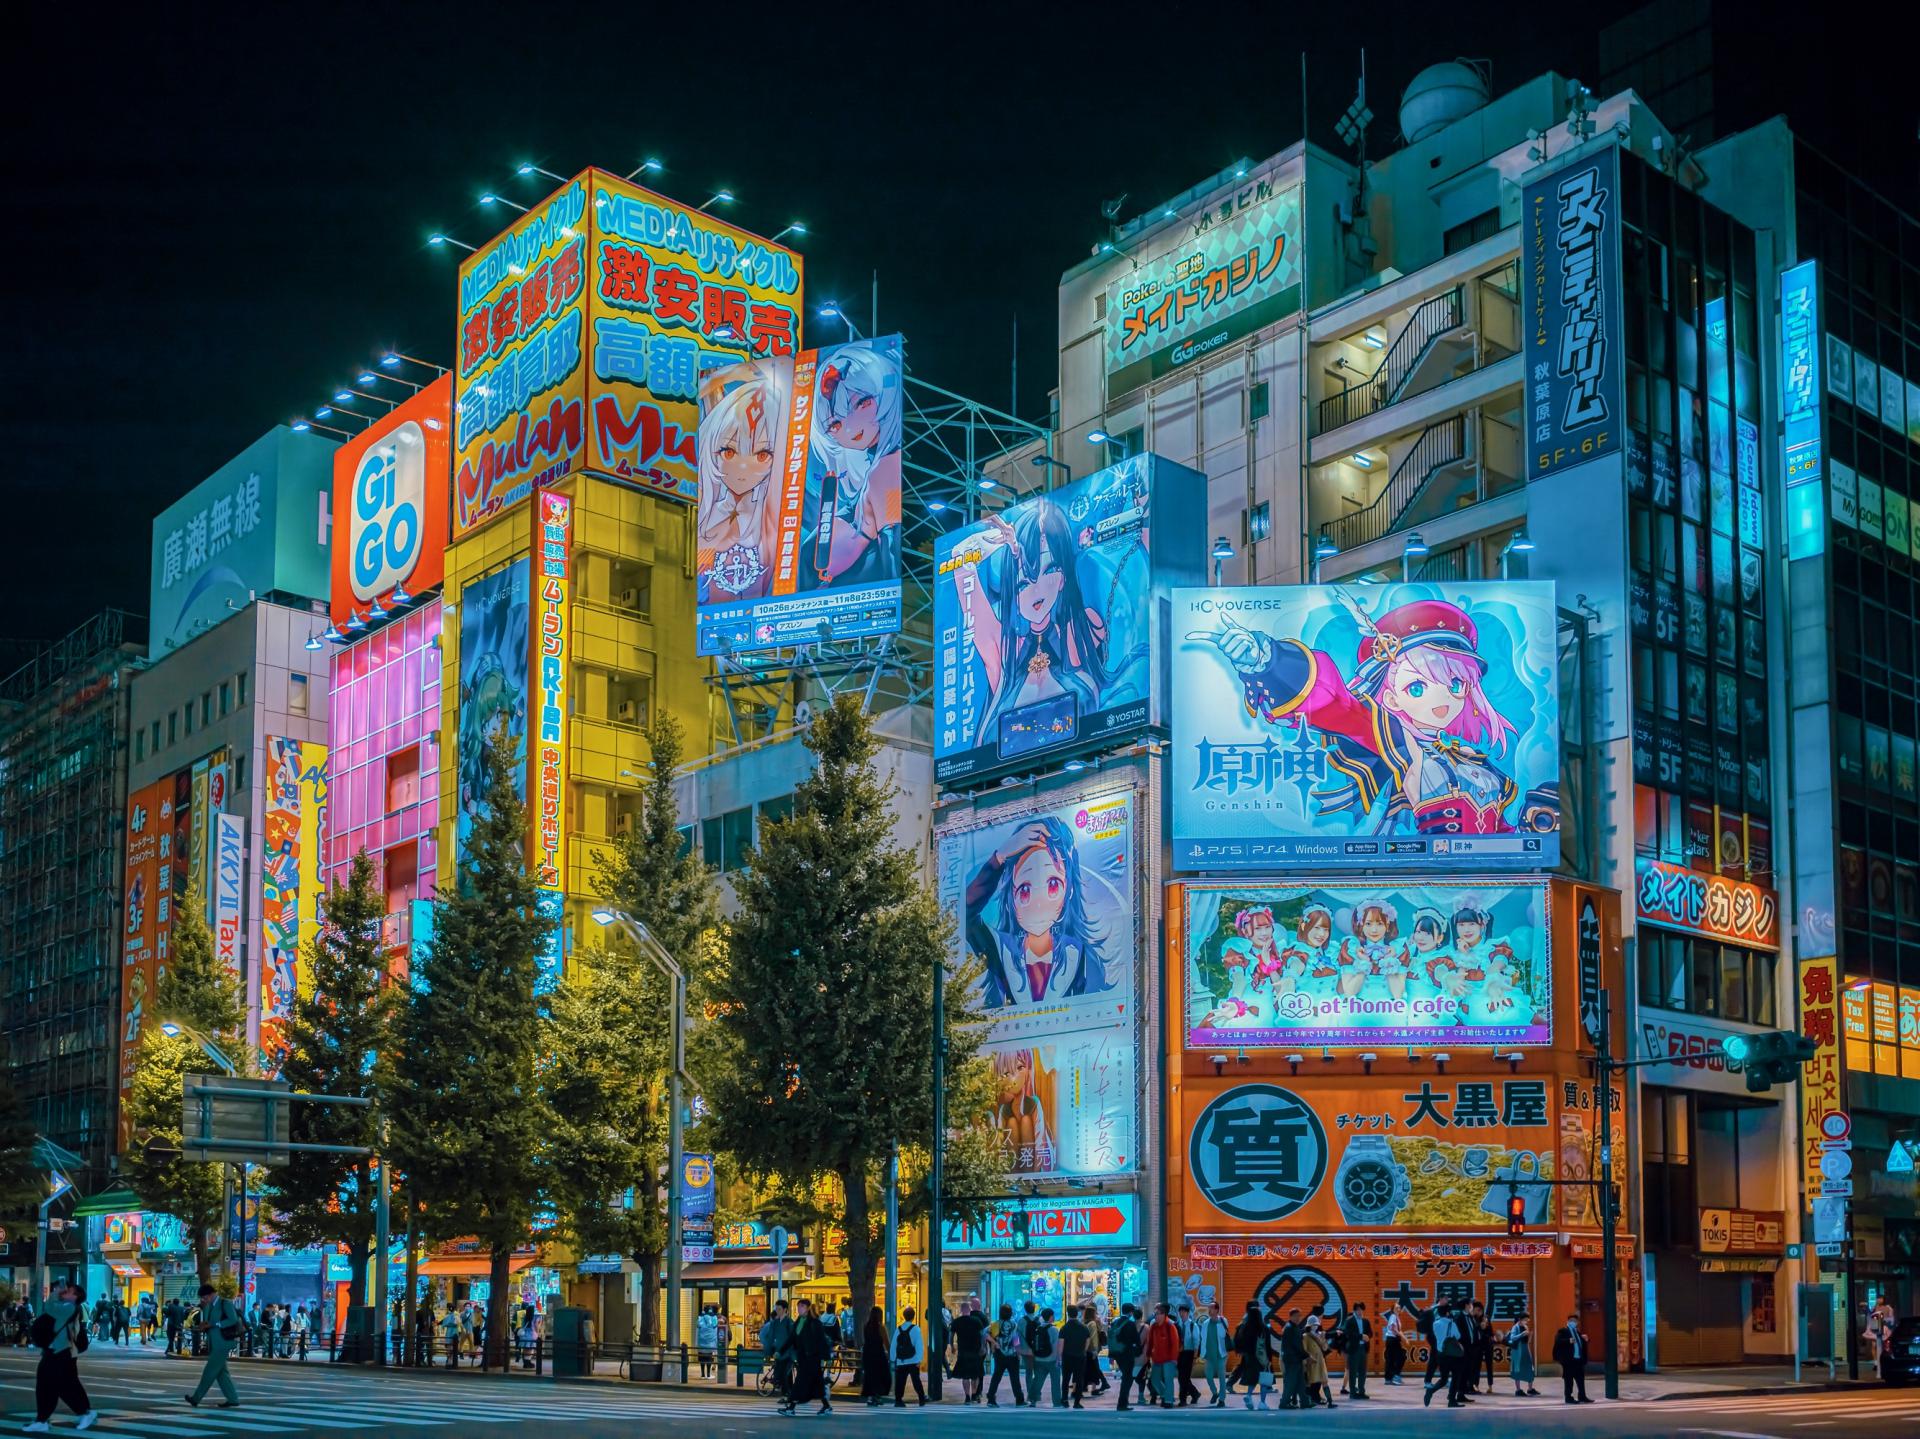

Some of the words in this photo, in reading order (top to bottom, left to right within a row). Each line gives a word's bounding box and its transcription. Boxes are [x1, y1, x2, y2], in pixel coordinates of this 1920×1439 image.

[595, 189, 799, 294] MEDIAリサイクル
[599, 240, 797, 357] 激安販売
[1122, 233, 1285, 350] メイドカジノ
[461, 237, 584, 378] 激安販売
[458, 307, 581, 453] 高額買取
[1534, 362, 1550, 444] 秋葉原店
[458, 396, 583, 528] Mulan
[1652, 474, 1675, 506] 7F
[161, 472, 262, 589] 廣瀬無線
[544, 525, 565, 543] 買取
[544, 542, 567, 560] 販売
[1191, 600, 1282, 613] HOYOVERSE
[779, 621, 802, 631] アズレン
[944, 629, 956, 641] CV
[1656, 610, 1679, 642] 6F
[1115, 708, 1145, 723] YOSTAR
[1192, 714, 1327, 819] 原神
[1659, 751, 1682, 784] 5F
[131, 804, 147, 833] 4F
[1206, 800, 1283, 811] Genshin
[221, 819, 239, 893] AKKY
[1207, 845, 1242, 855] PS5
[1252, 844, 1288, 854] PS4
[1295, 844, 1338, 854] Windows
[1454, 842, 1473, 851] 原神
[1640, 867, 1774, 939] メイドカジノ
[128, 904, 143, 934] 3F
[1289, 998, 1304, 1009] at
[1412, 995, 1458, 1014] cafe
[1803, 966, 1835, 1047] 免税
[1846, 1001, 1863, 1017] Tax
[125, 1011, 140, 1041] 2F
[1404, 1081, 1548, 1129] 大黒屋
[1336, 1113, 1396, 1129] チケット
[1826, 1119, 1843, 1132] 40
[1207, 1105, 1314, 1204] 質
[1827, 1159, 1839, 1175] P
[1062, 1210, 1091, 1234] ZIN
[1703, 1229, 1728, 1240] TOKIS
[1194, 1244, 1243, 1256] 高価買取
[1501, 1243, 1552, 1256] 無料査定
[1415, 1259, 1496, 1276] チケット
